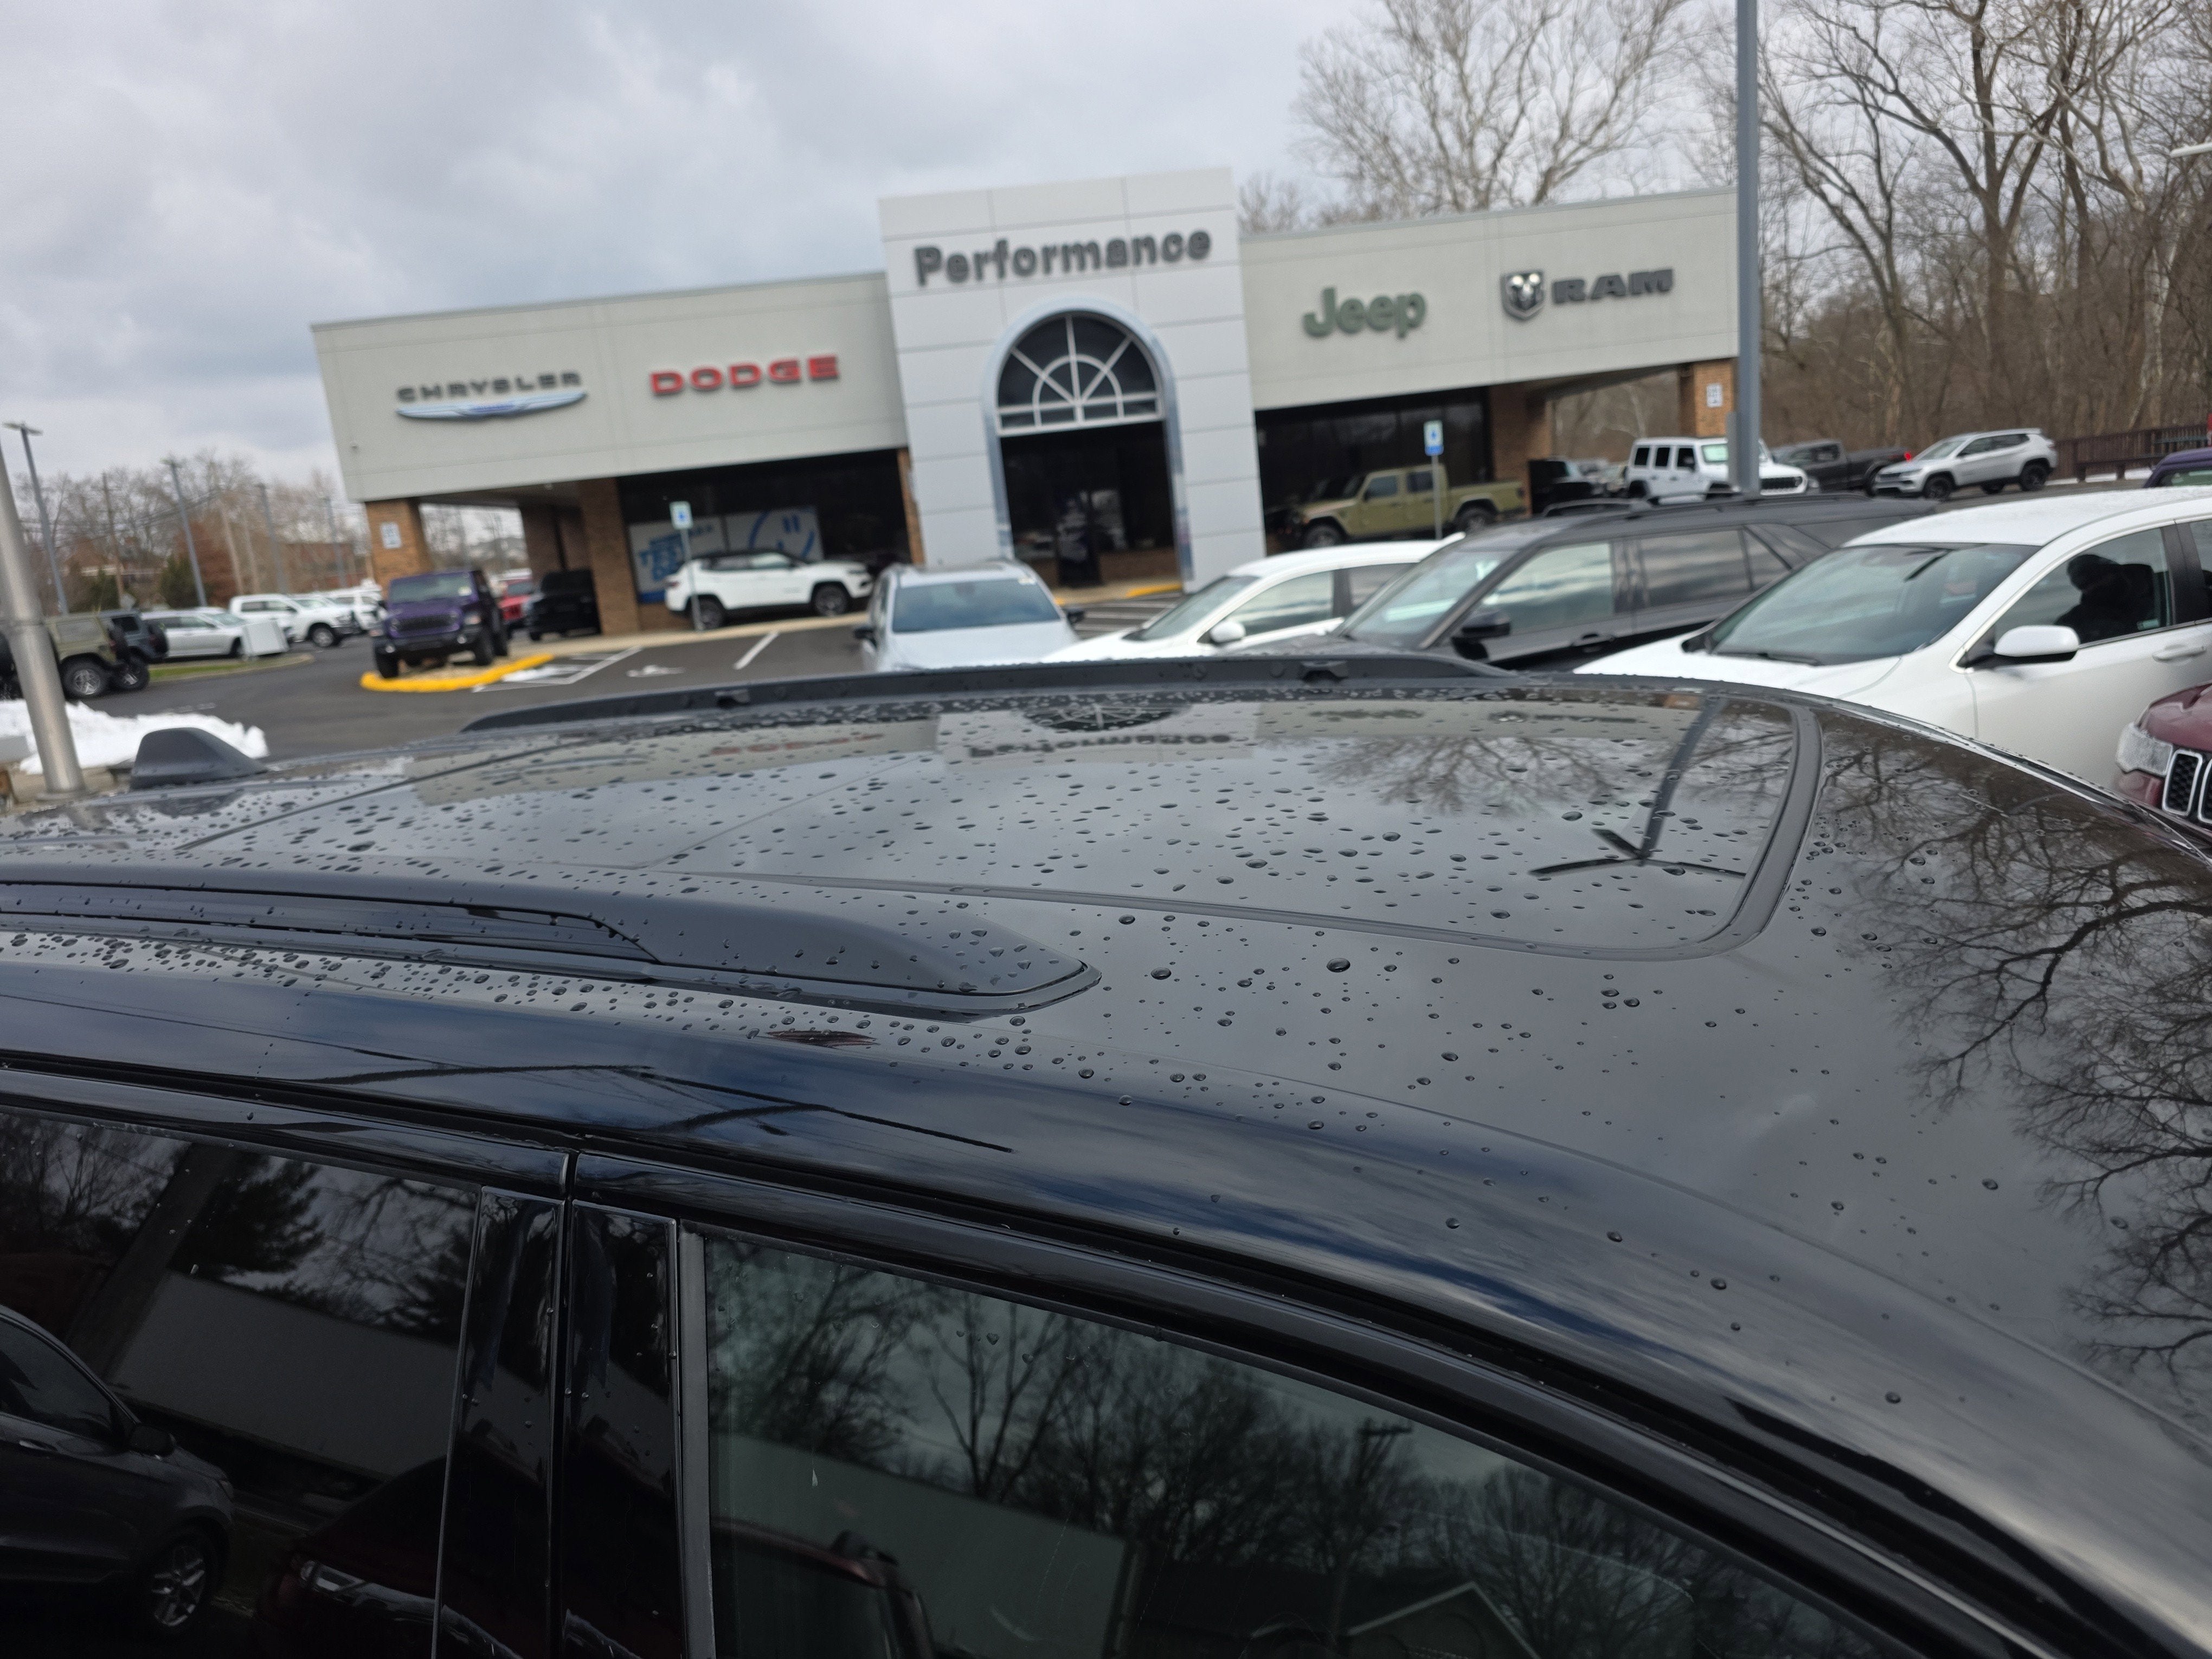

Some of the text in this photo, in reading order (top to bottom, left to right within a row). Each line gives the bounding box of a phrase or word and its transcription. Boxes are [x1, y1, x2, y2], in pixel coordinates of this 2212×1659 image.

[913, 229, 1212, 287] Performance
[1552, 269, 1673, 305] RAM
[1303, 286, 1427, 340] Jeep
[397, 371, 582, 402] CHRYSLER
[650, 355, 840, 395] DODGE
